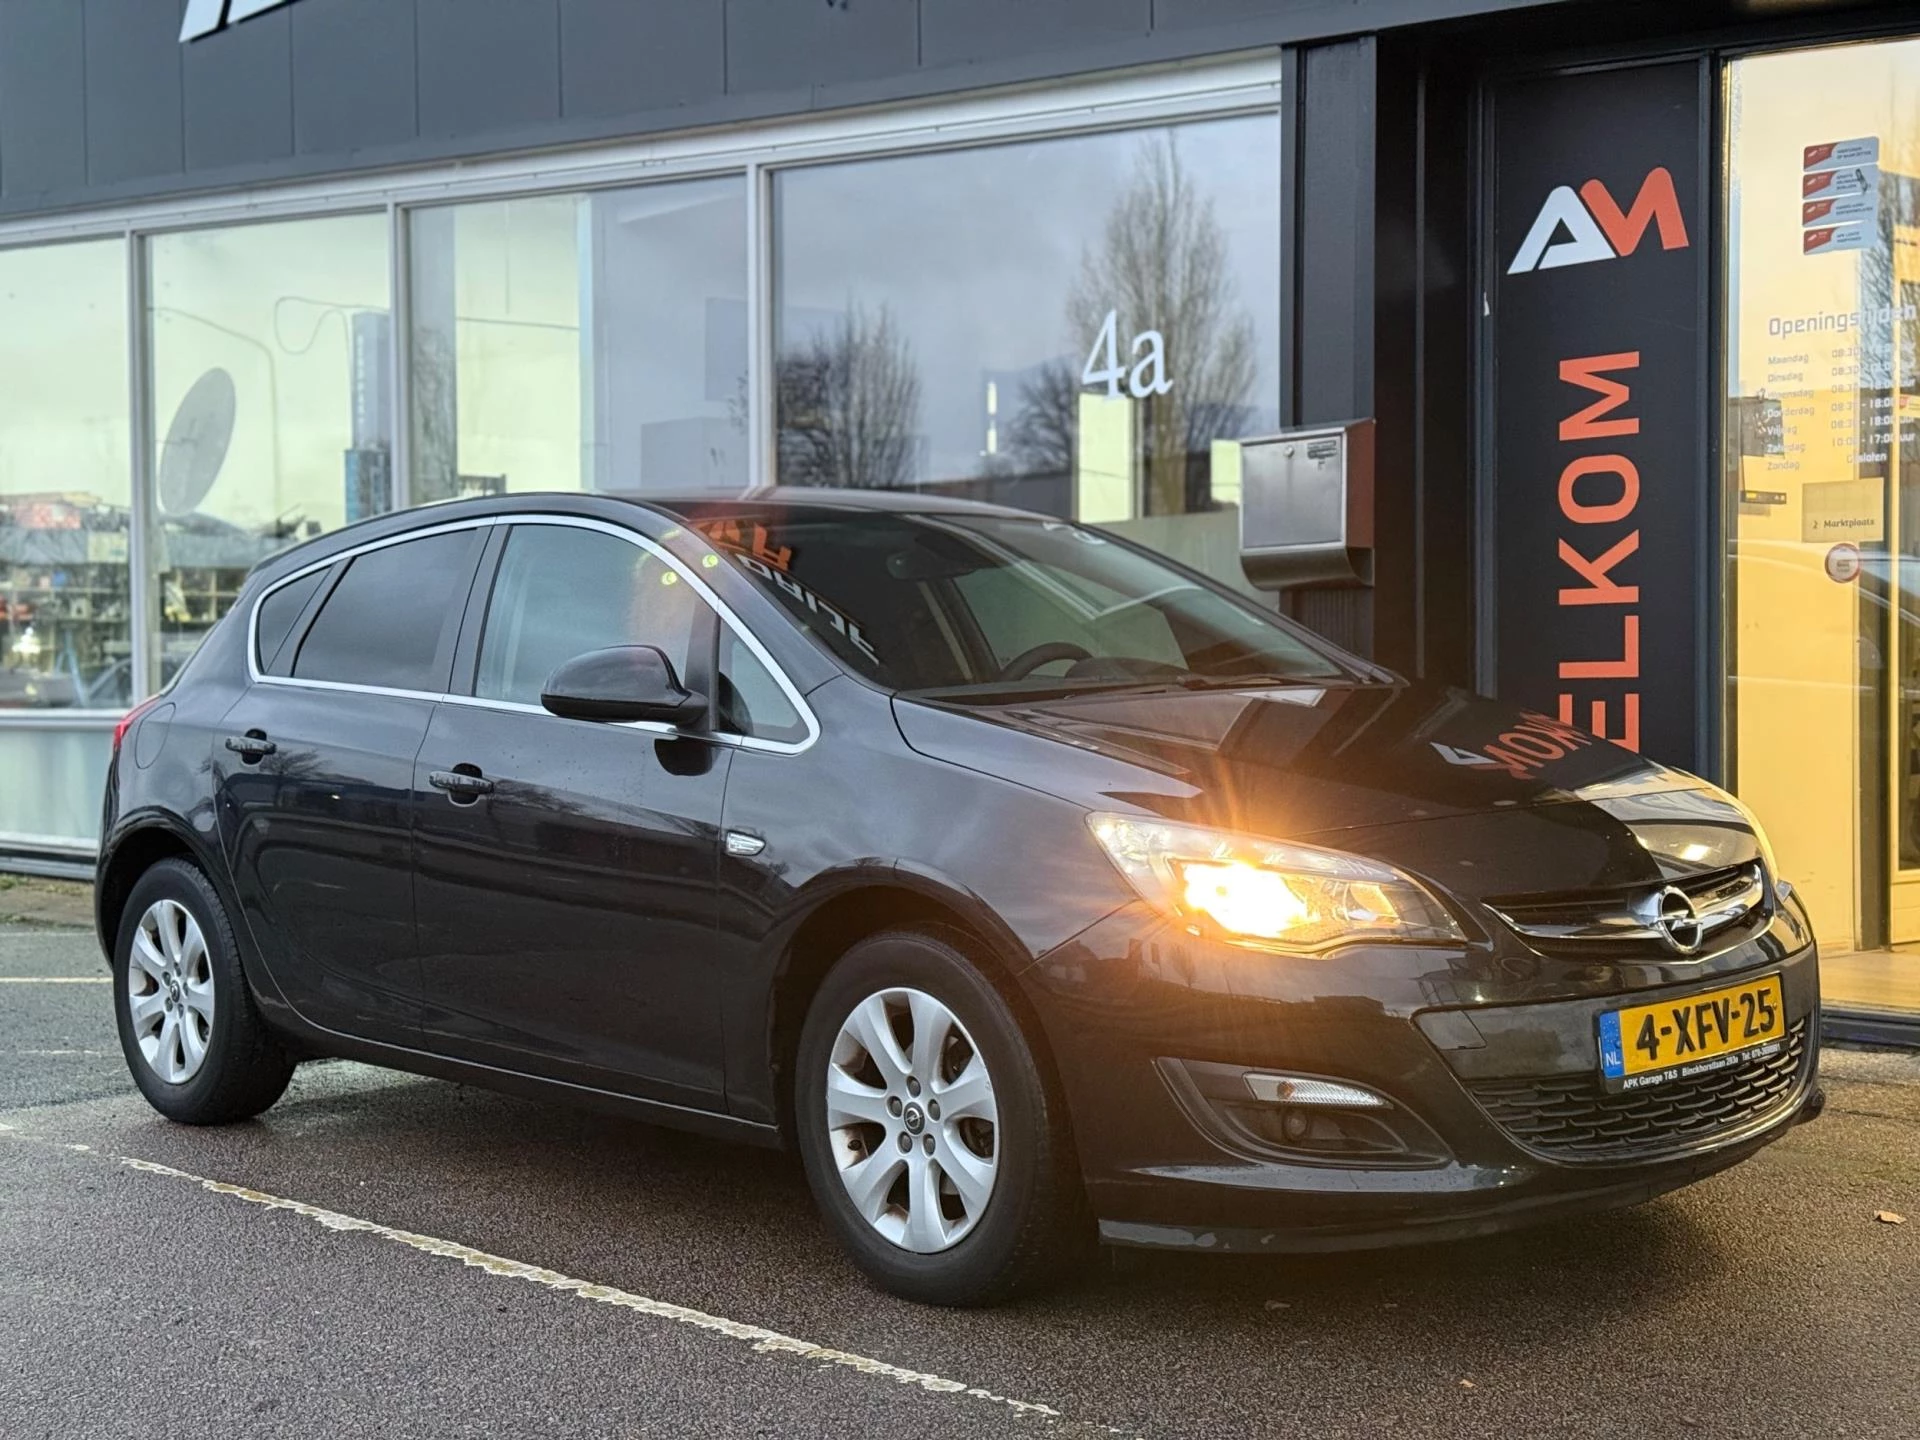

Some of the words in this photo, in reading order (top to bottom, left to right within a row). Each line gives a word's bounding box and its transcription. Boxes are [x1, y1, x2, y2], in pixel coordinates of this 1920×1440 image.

[1506, 166, 1690, 275] AM
[1082, 309, 1174, 400] 4a
[1768, 353, 1809, 365] Maandag
[1768, 371, 1804, 383] Dinsdag
[1767, 460, 1801, 471] Zondag
[1823, 517, 1876, 531] Marktplaats
[1635, 988, 1776, 1061] 4-XFV-25
[1605, 1051, 1621, 1067] NL
[1623, 1078, 1639, 1090] APK
[1639, 1074, 1664, 1086] Garage
[1663, 1069, 1679, 1081] T&S
